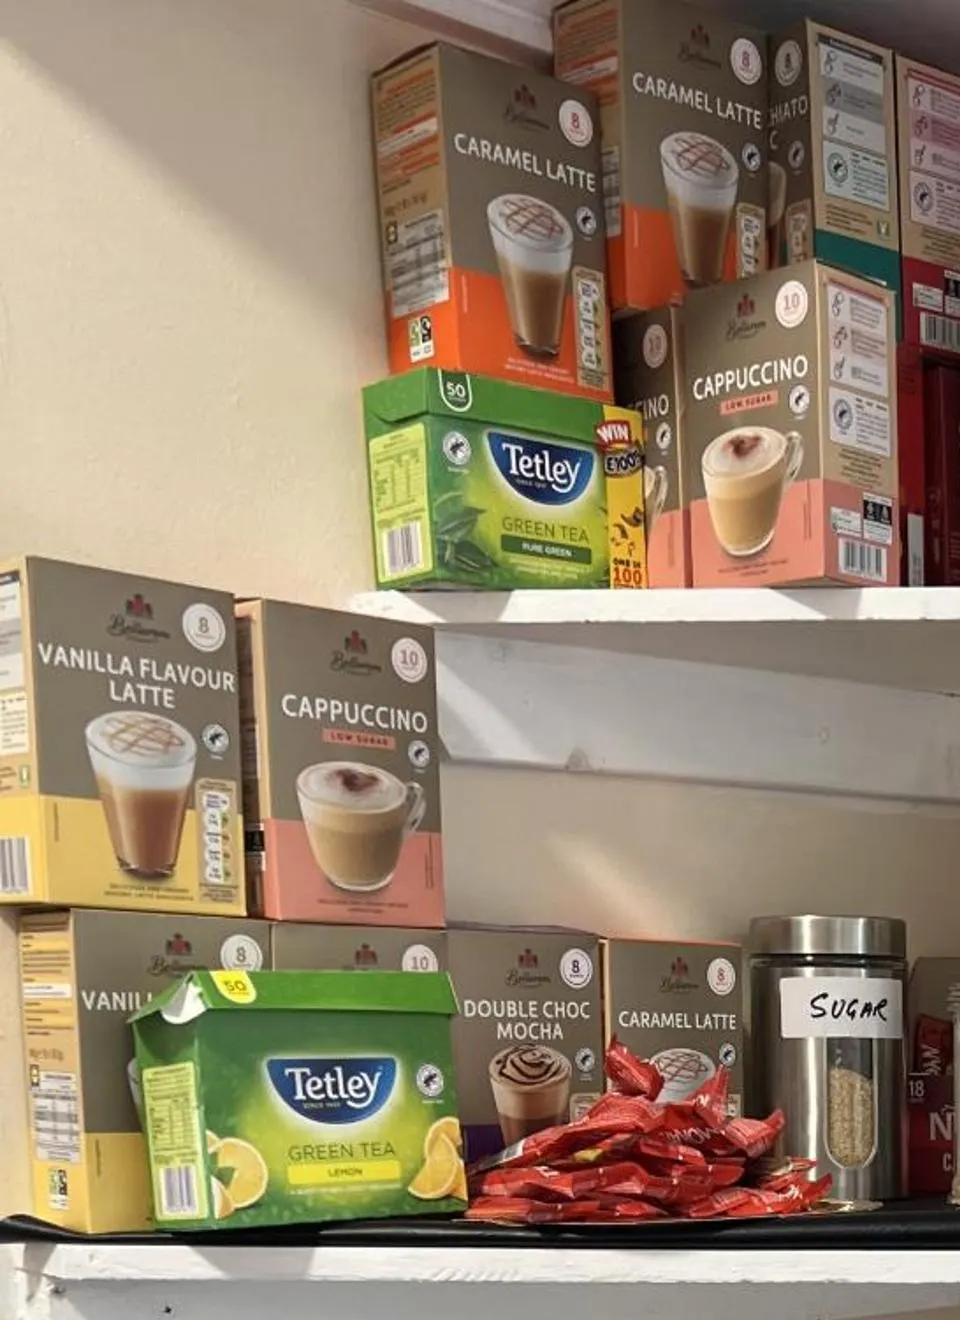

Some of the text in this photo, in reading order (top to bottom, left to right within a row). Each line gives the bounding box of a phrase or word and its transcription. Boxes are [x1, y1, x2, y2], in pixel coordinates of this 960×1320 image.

[632, 71, 762, 130] CARAMEL LATTE
[571, 111, 581, 129] 8
[453, 132, 597, 193] CARAMEL LATTE
[783, 292, 800, 311] 10
[693, 354, 809, 401] CAPPUCCINO
[445, 382, 467, 398] 50
[597, 423, 629, 442] WIN
[501, 442, 580, 494] Tetley
[501, 516, 590, 545] GREEN TEA
[521, 541, 573, 558] PURE GREEN
[612, 567, 643, 586] 100
[198, 616, 210, 634] 8
[37, 641, 236, 692] VANILLA FLAVOUR
[399, 649, 419, 666] 10
[108, 679, 176, 710] LATTE
[281, 693, 429, 734] CAPPUCCINO
[236, 946, 247, 962] 8
[411, 956, 429, 970] 10
[571, 959, 580, 974] 8
[224, 979, 247, 992] 50
[463, 1000, 591, 1019] DOUBLE CHOC
[809, 992, 888, 1022] SUGAR
[618, 1010, 737, 1030] CARAMEL LATTE
[496, 1022, 564, 1040] MOCHA
[284, 1065, 383, 1109] Tetley
[907, 1080, 926, 1098] 18
[288, 1141, 396, 1162] GREEN TEA
[326, 1167, 364, 1178] LEMON
